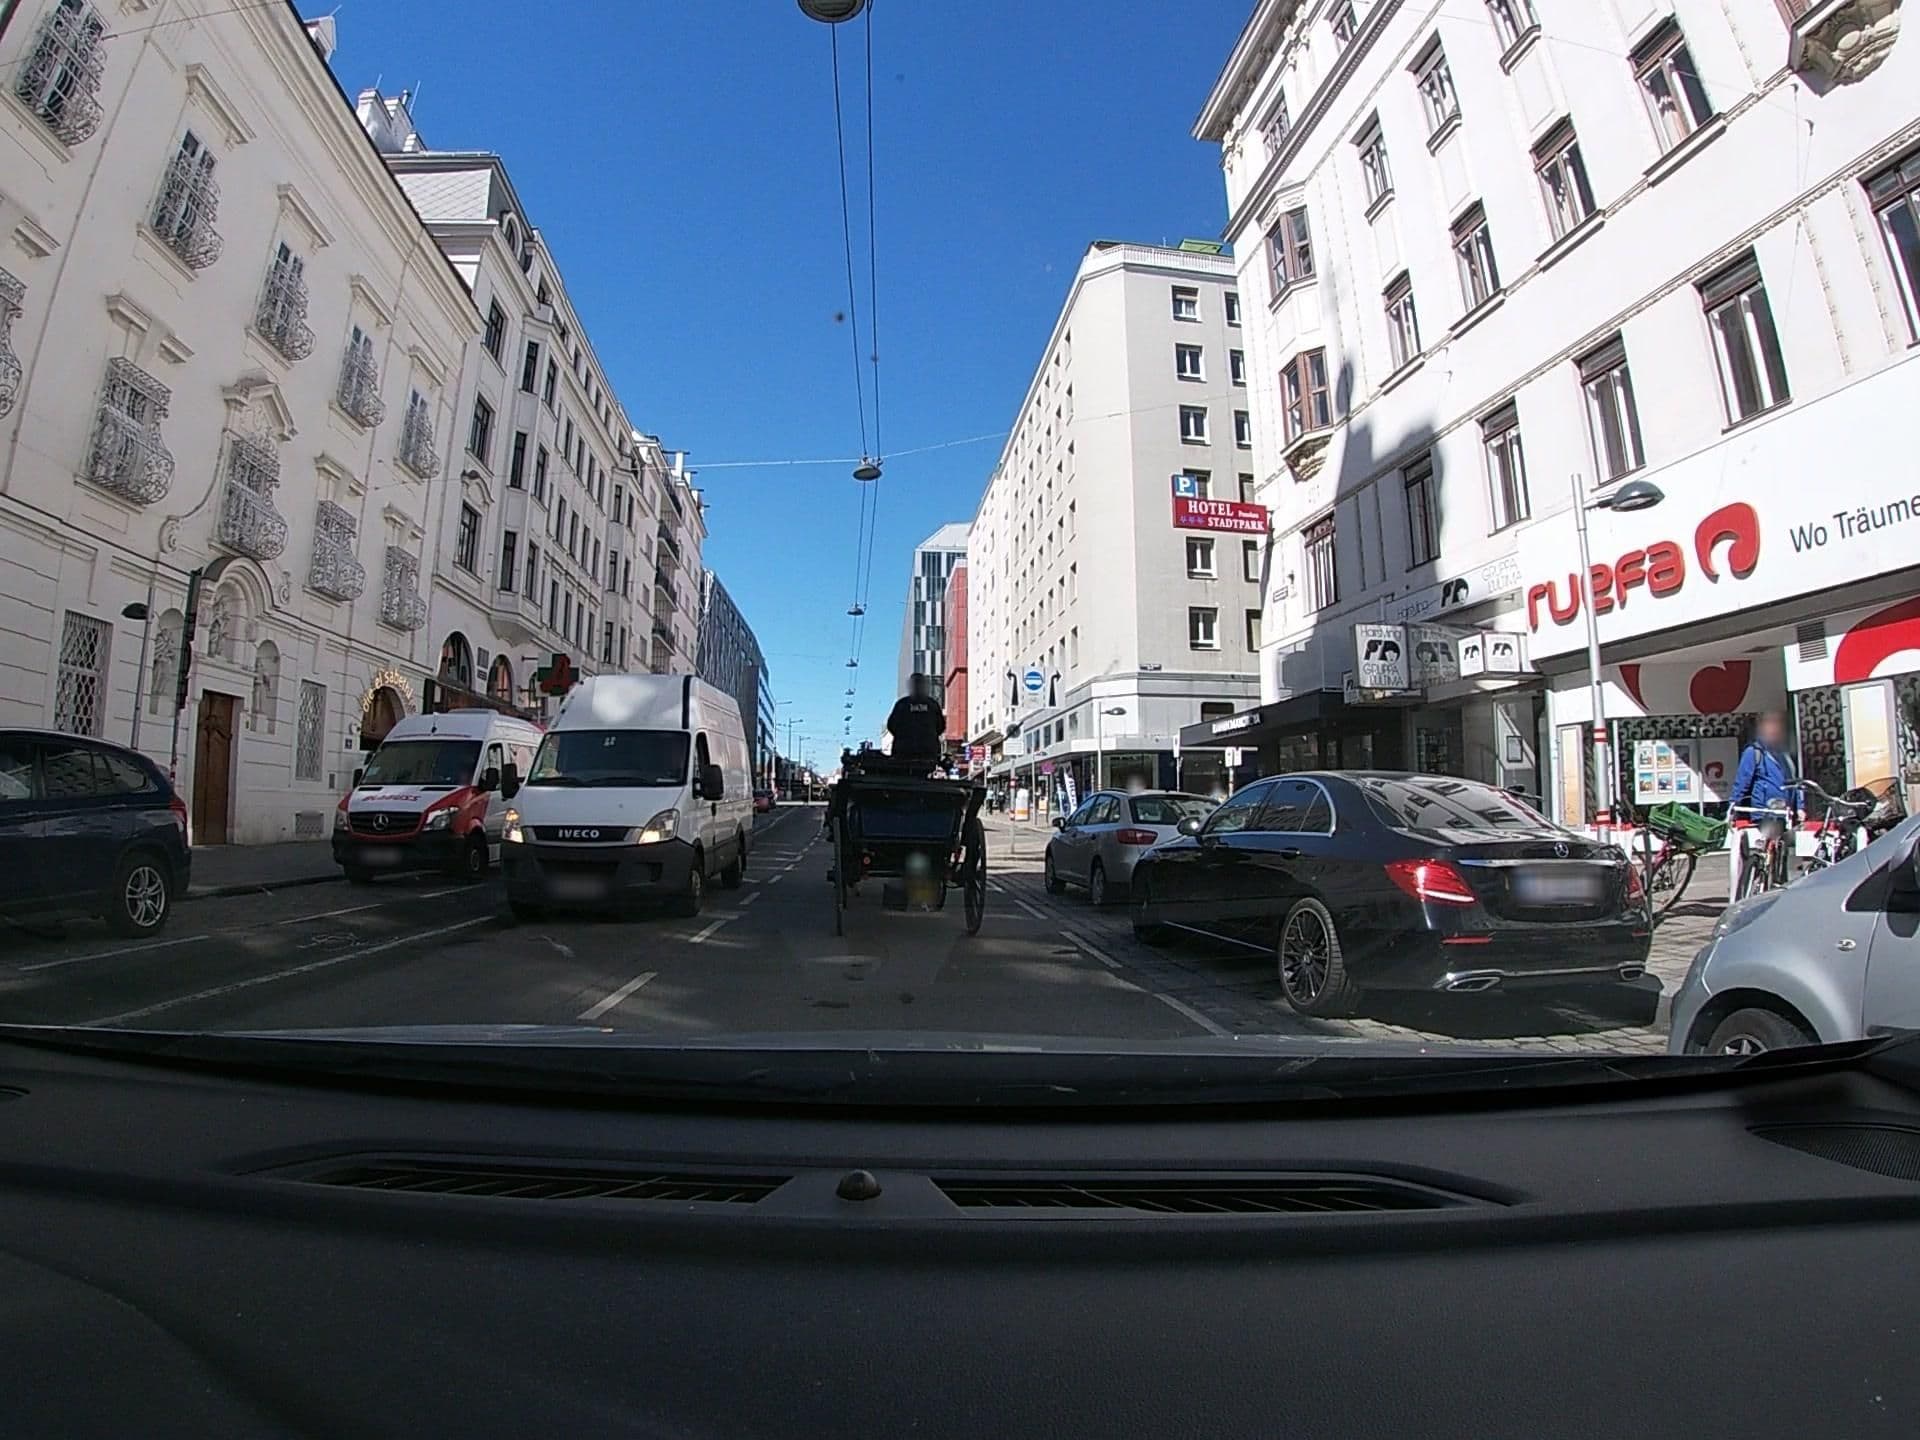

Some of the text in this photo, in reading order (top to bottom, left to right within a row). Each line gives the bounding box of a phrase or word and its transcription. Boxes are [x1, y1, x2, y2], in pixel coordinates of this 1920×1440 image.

[1188, 501, 1233, 516] HOTEL
[1207, 517, 1264, 530] STADTPARK
[1789, 521, 1828, 553] Wo
[1527, 540, 1686, 632] ruefa
[558, 829, 600, 839] IVECO
